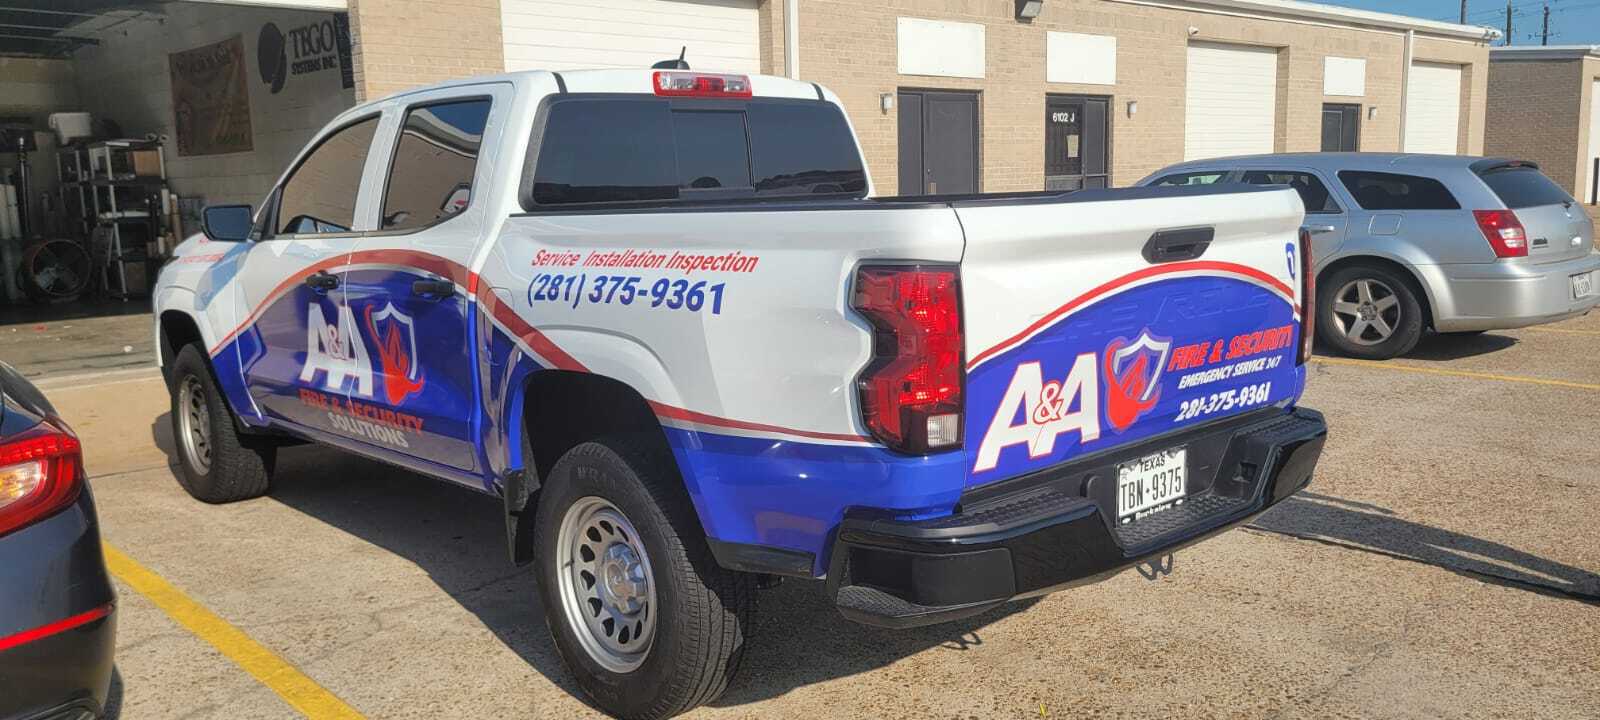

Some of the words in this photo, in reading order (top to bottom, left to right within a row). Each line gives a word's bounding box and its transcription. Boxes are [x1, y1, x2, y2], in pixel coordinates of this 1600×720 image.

[289, 20, 334, 58] TEGO
[1052, 112, 1068, 122] 6102
[1070, 112, 1075, 122] J
[532, 250, 580, 267] Service
[584, 249, 665, 268] Installation
[666, 251, 759, 275] Inspection
[528, 273, 586, 309] (281)
[588, 275, 726, 314] 375-9361
[299, 302, 373, 397] A&A
[1167, 343, 1210, 371] FIRE
[1209, 339, 1224, 362] &
[1178, 364, 1233, 389] EMERGENCY
[1232, 357, 1266, 377] SERVICE
[299, 388, 329, 410] FIRE
[332, 397, 344, 416] &
[345, 399, 424, 436] SECURITY
[972, 352, 1100, 473] A&A
[1174, 382, 1271, 422] 281-375-9361
[328, 412, 408, 448] SOLUTIONS
[1140, 457, 1166, 473] TEXAS
